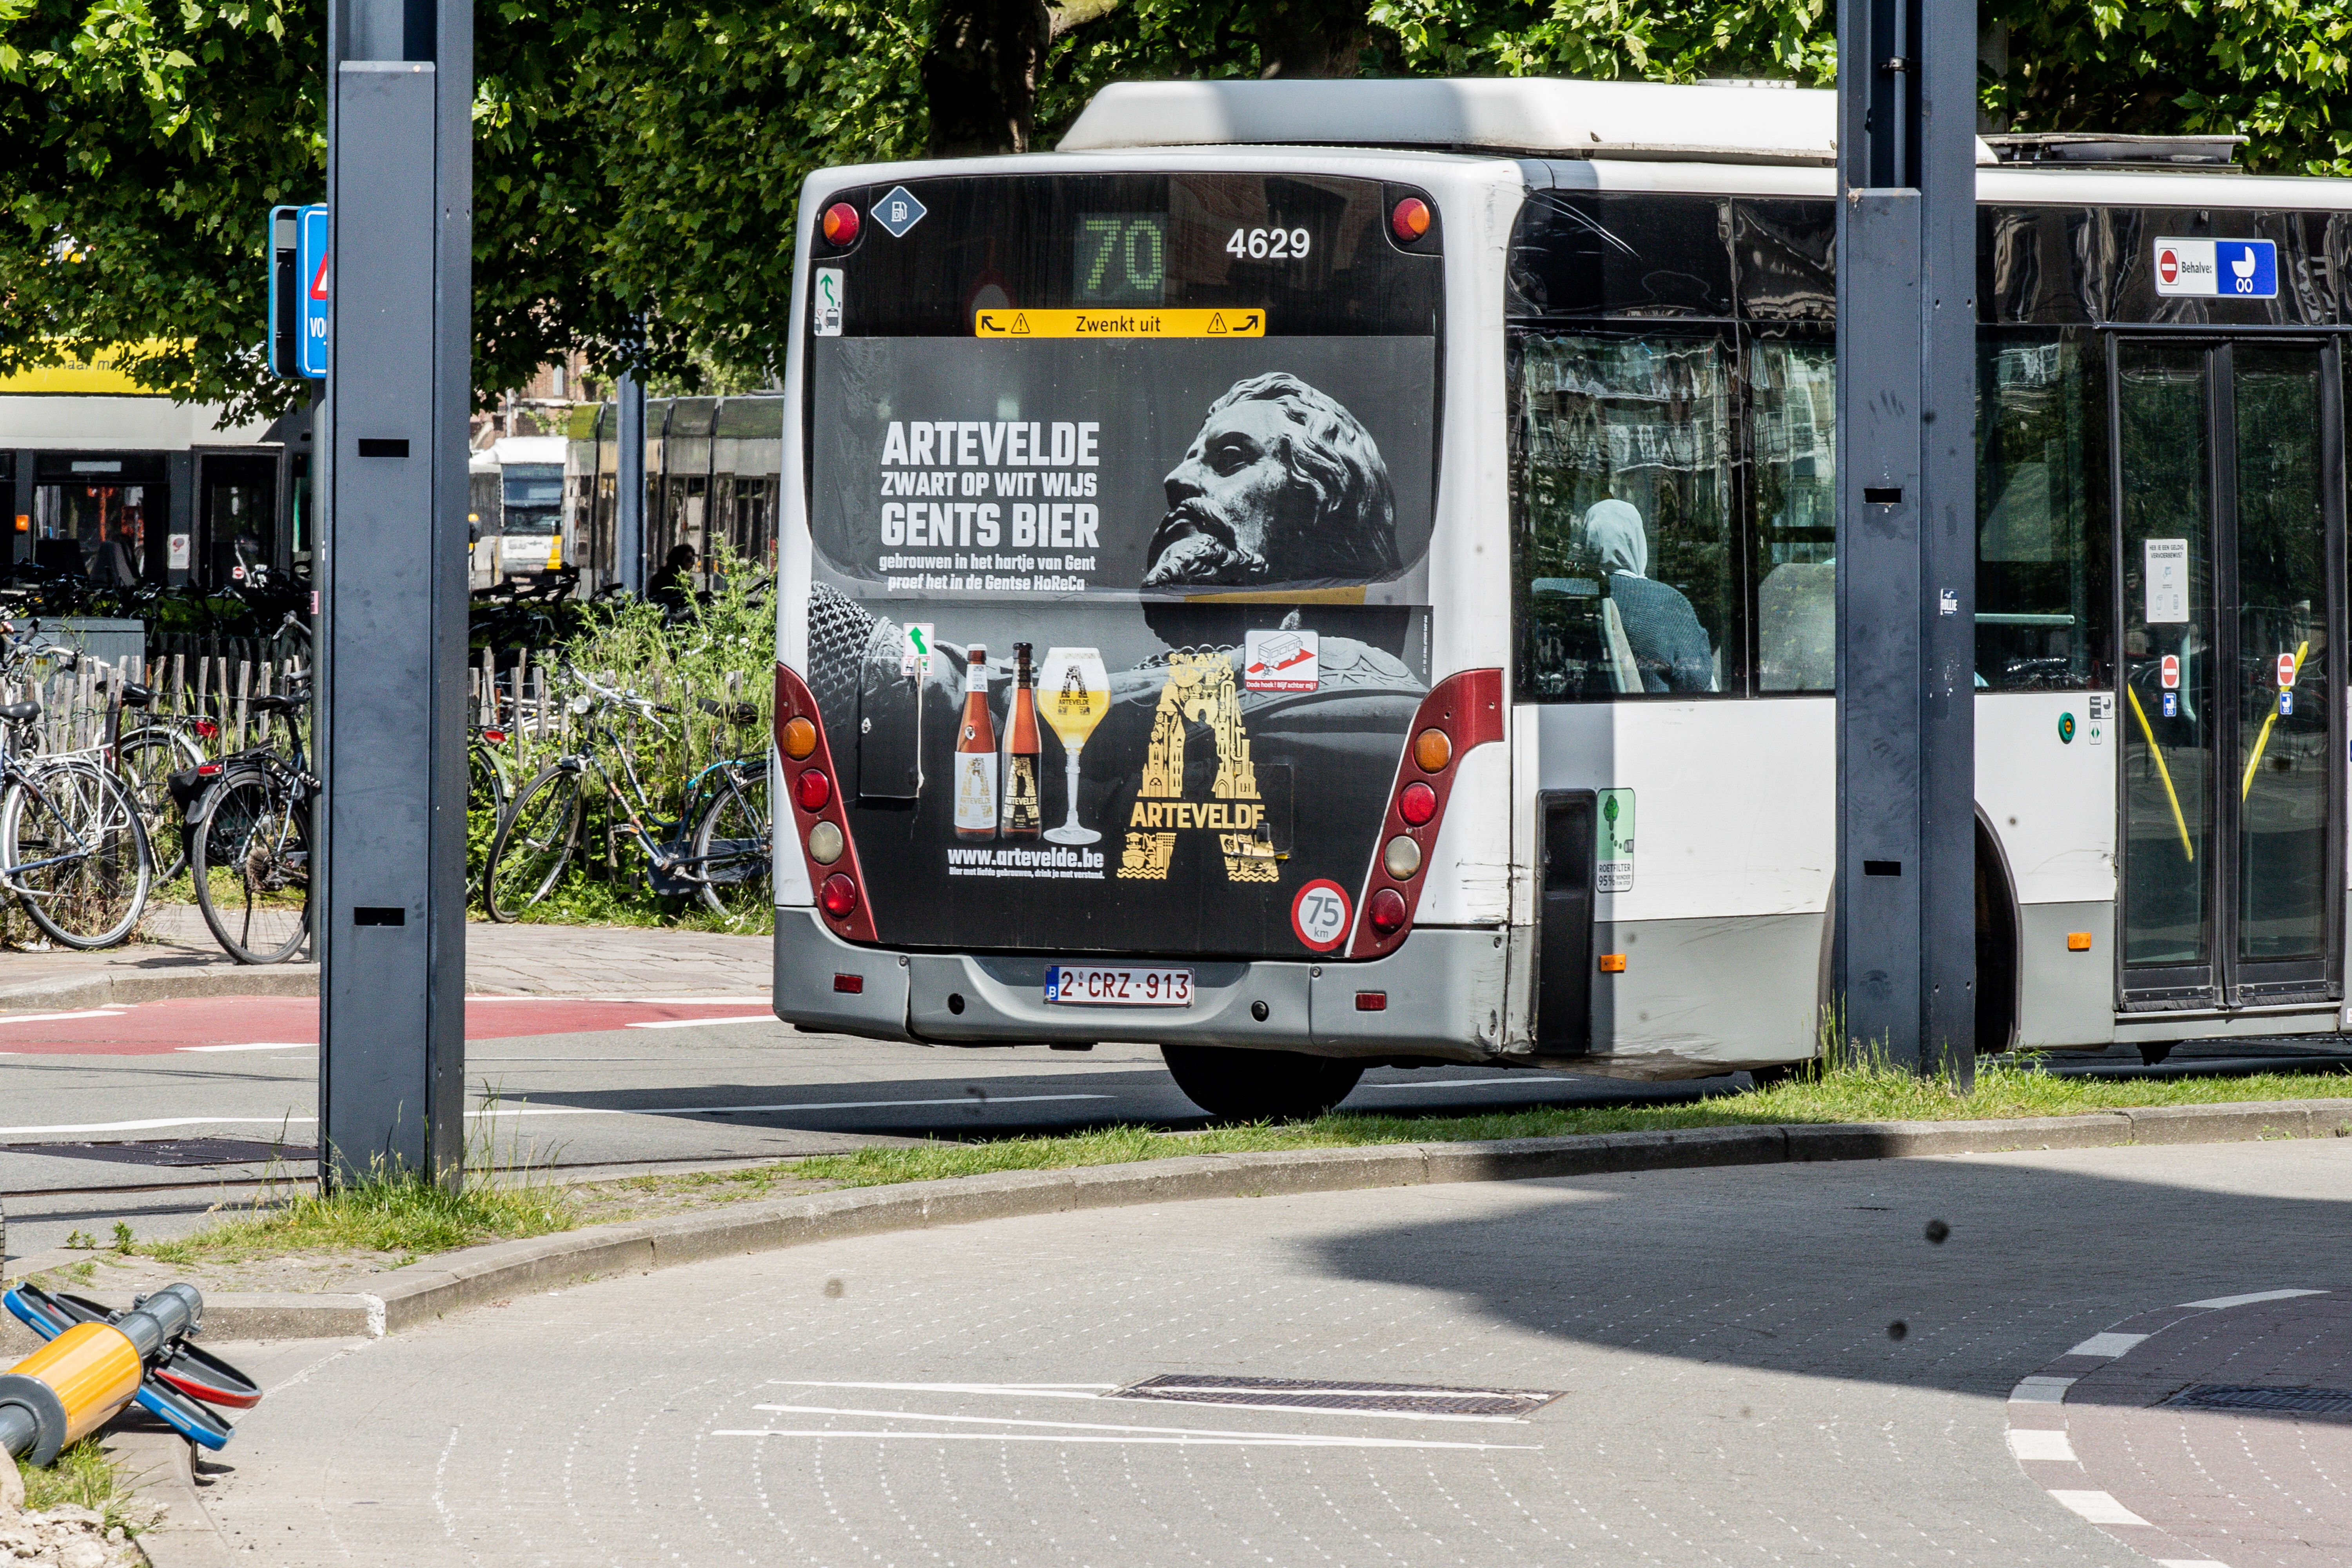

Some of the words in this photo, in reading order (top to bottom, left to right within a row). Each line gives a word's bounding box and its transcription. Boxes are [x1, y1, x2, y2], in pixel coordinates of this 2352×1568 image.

[1227, 229, 1310, 258] 4629
[1086, 220, 1161, 289] 70
[2181, 261, 2212, 274] Behalve:
[1076, 316, 1134, 332] Zwenkt
[1140, 316, 1161, 332] uit
[881, 421, 1100, 466] ARTEVELDE
[881, 472, 957, 496] ZWART
[961, 472, 989, 496] OP
[994, 472, 1037, 497] WIT
[1041, 472, 1097, 497] WIJS
[881, 503, 1000, 547] GENTS
[1012, 503, 1100, 548] BIER
[879, 553, 952, 571] gebrouwen
[955, 553, 967, 569] in
[971, 553, 993, 569] het
[995, 554, 1034, 572] hartje
[1037, 557, 1062, 570] van
[1065, 555, 1096, 570] Gent
[888, 573, 924, 591] proef
[926, 573, 948, 589] het
[950, 573, 963, 589] in
[966, 574, 982, 590] de
[985, 575, 1031, 590] Gentse
[1033, 575, 1085, 591] HoReCa
[1005, 796, 1037, 805] ARTEVELDE
[1130, 802, 1265, 829] ARTEVELDE
[947, 847, 1104, 868] www.artevelde.be
[1599, 864, 1631, 872] ROETFILTER
[1599, 875, 1615, 886] 95%
[1308, 896, 1339, 926] 75
[1314, 927, 1328, 938] km
[1049, 986, 1056, 997] B
